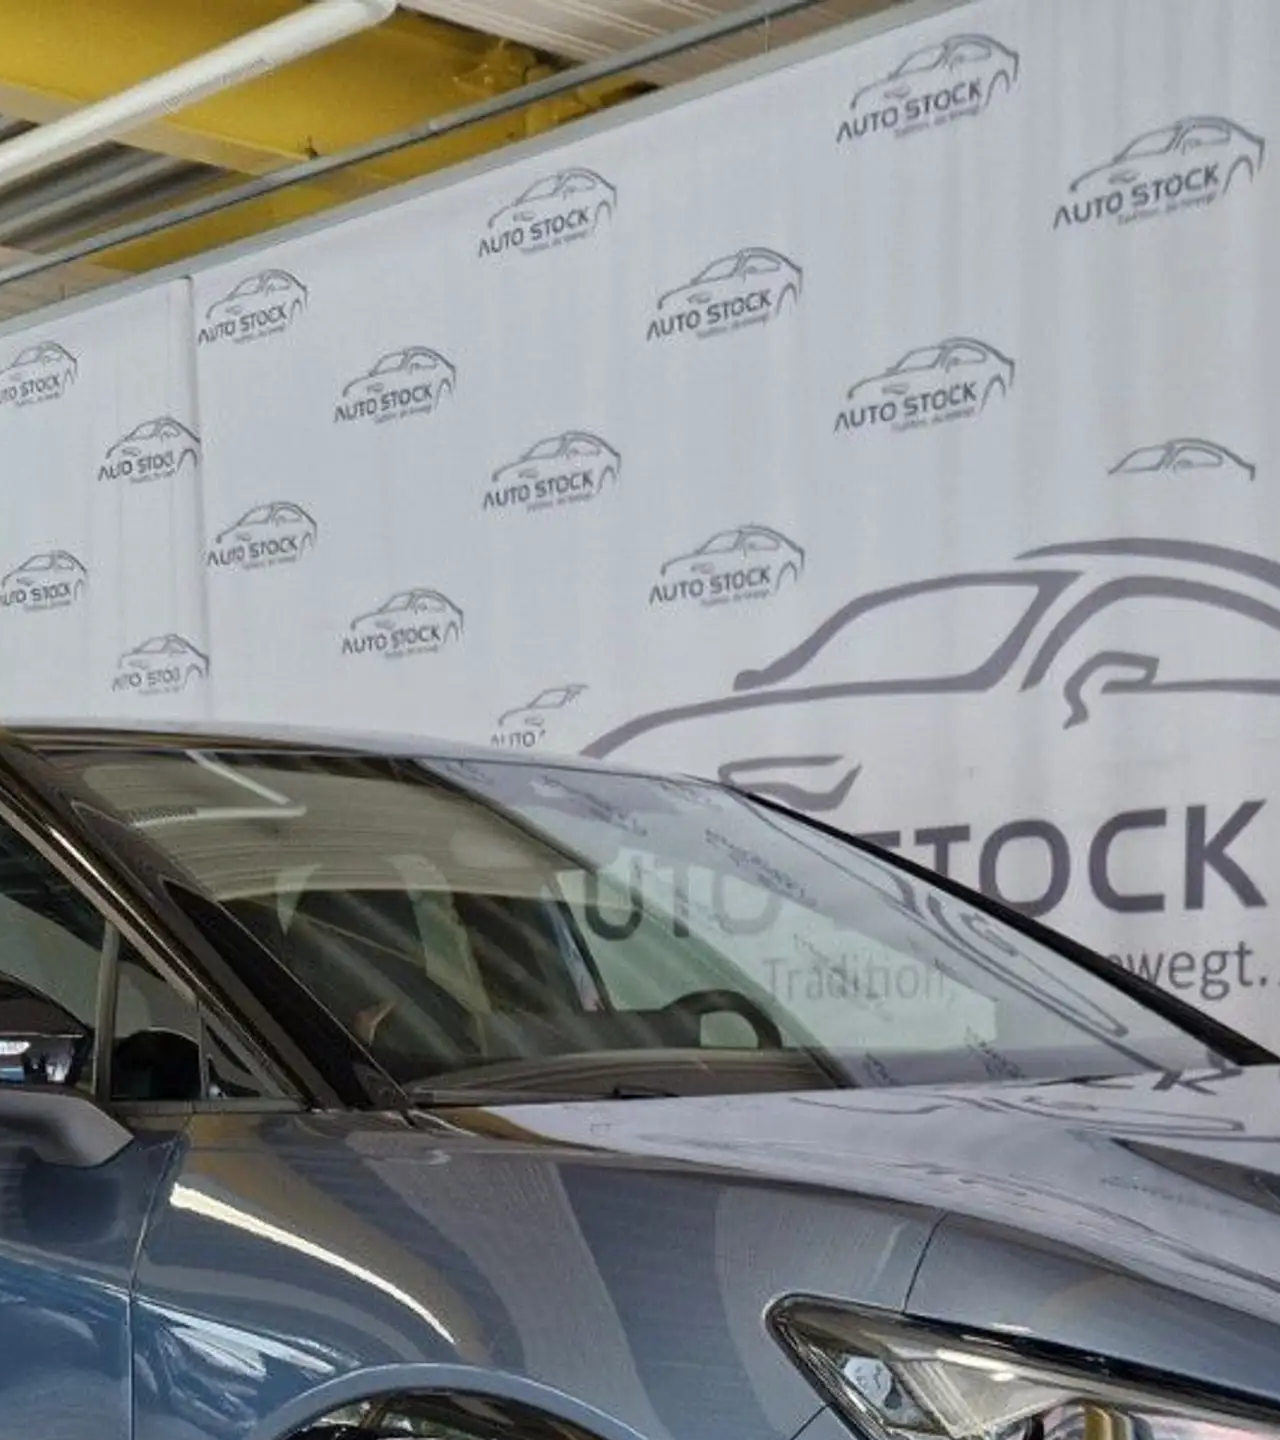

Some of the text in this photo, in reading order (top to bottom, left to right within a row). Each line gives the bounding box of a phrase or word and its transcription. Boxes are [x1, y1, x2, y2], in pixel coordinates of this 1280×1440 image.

[836, 105, 898, 143] AUTO
[905, 77, 983, 121] STOCK
[1052, 192, 1123, 230] AUTO
[1130, 163, 1219, 208] STOCK
[478, 227, 523, 257] AUTO
[531, 206, 589, 241] STOCK
[198, 321, 236, 345] AUTO
[240, 303, 287, 331] STOCK
[646, 309, 701, 341] AUTO
[707, 289, 772, 325] STOCK
[333, 399, 376, 423] AUTO
[382, 384, 433, 410] STOCK
[833, 401, 896, 433] AUTO
[903, 381, 976, 418] STOCK
[482, 484, 529, 511] AUTO
[535, 469, 594, 498] STOCK
[649, 578, 703, 605] AUTO
[710, 564, 771, 594] STOCK
[341, 634, 387, 655] AUTO
[391, 625, 441, 649] STOCK
[856, 799, 1268, 917] TOCK
